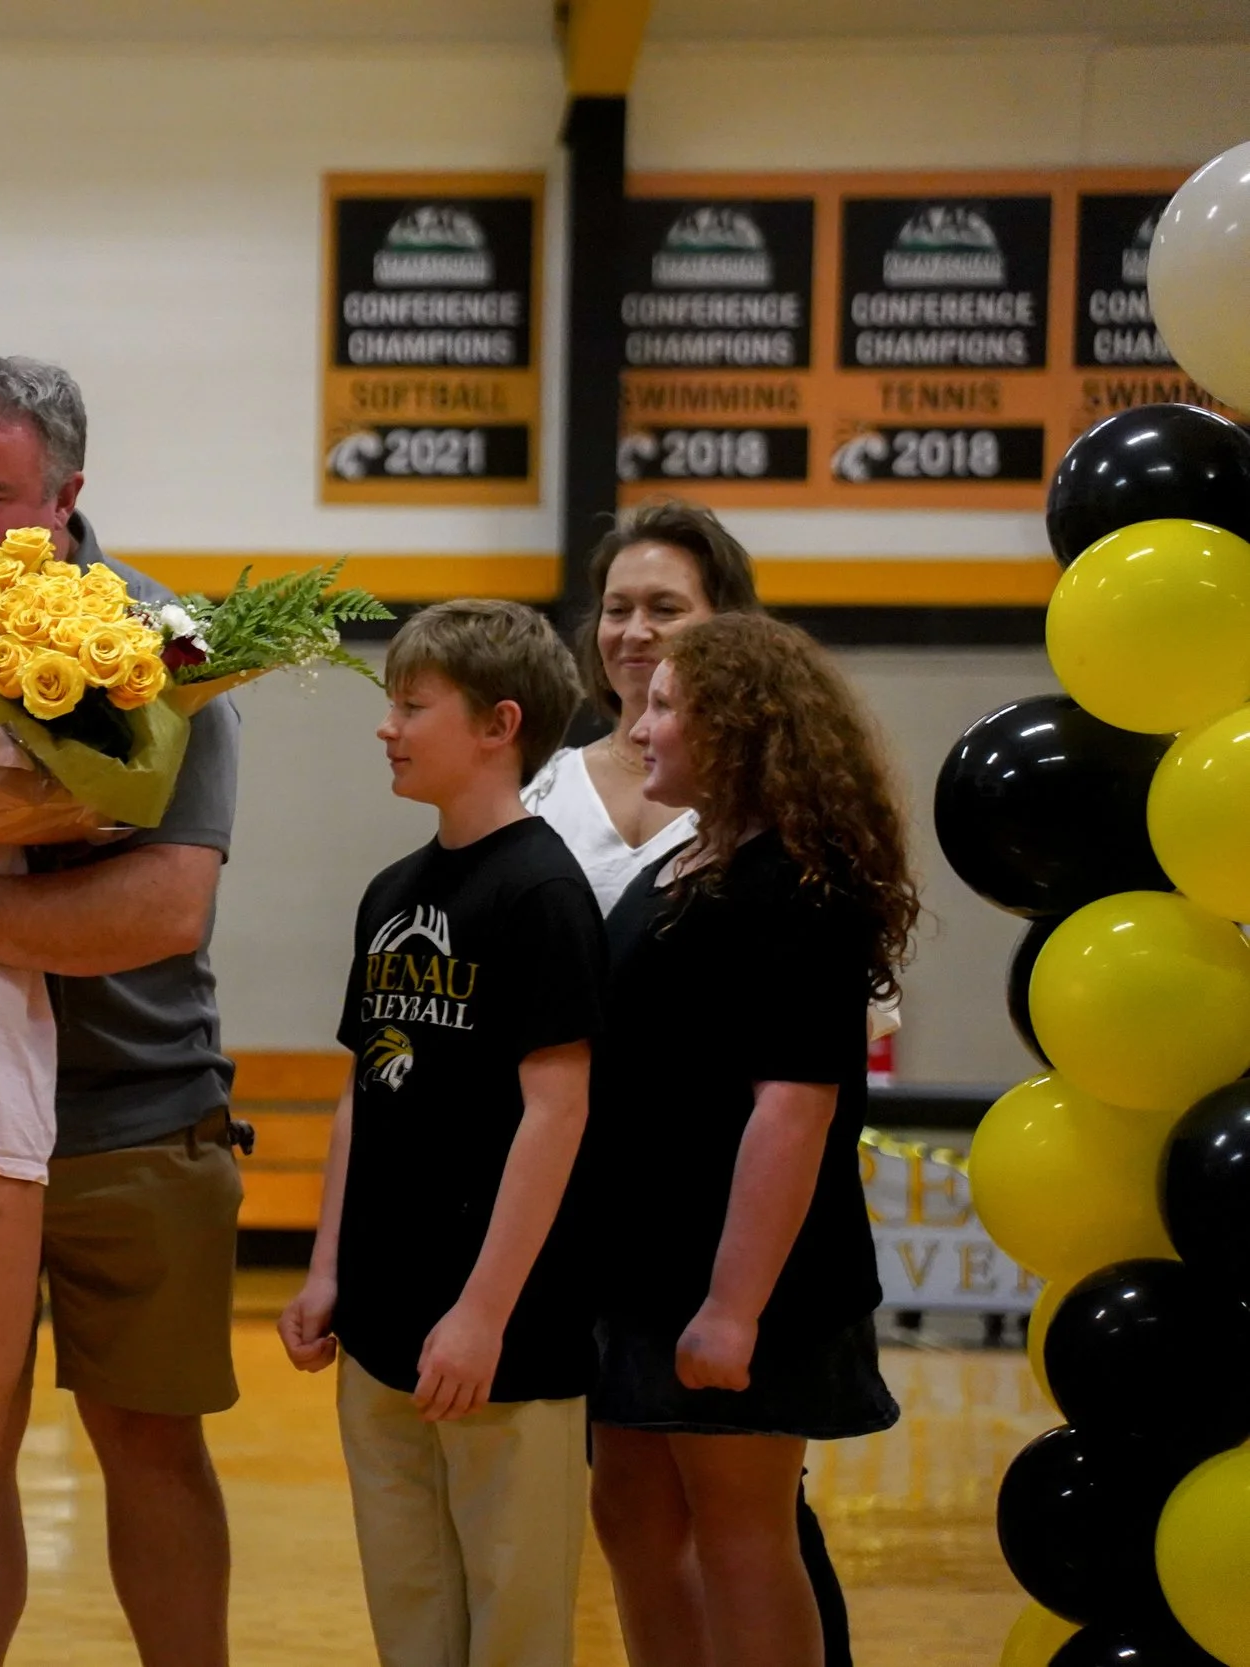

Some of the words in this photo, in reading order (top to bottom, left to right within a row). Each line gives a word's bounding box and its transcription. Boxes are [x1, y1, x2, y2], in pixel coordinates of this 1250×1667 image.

[344, 290, 521, 327] CONFERENCE
[621, 291, 802, 328] CONFERENCE
[851, 292, 1035, 328] CONFERENCE
[348, 328, 516, 364] CHAMPIONS
[625, 330, 795, 366] CHAMPIONS
[856, 330, 1029, 364] CHAMPIONS
[353, 381, 507, 411] SOFTBALL
[880, 382, 1000, 410] TENNIS
[1081, 378, 1224, 410] SWIMM
[384, 428, 486, 475] 2021
[661, 429, 770, 477] 2018
[892, 430, 1000, 477] 2018
